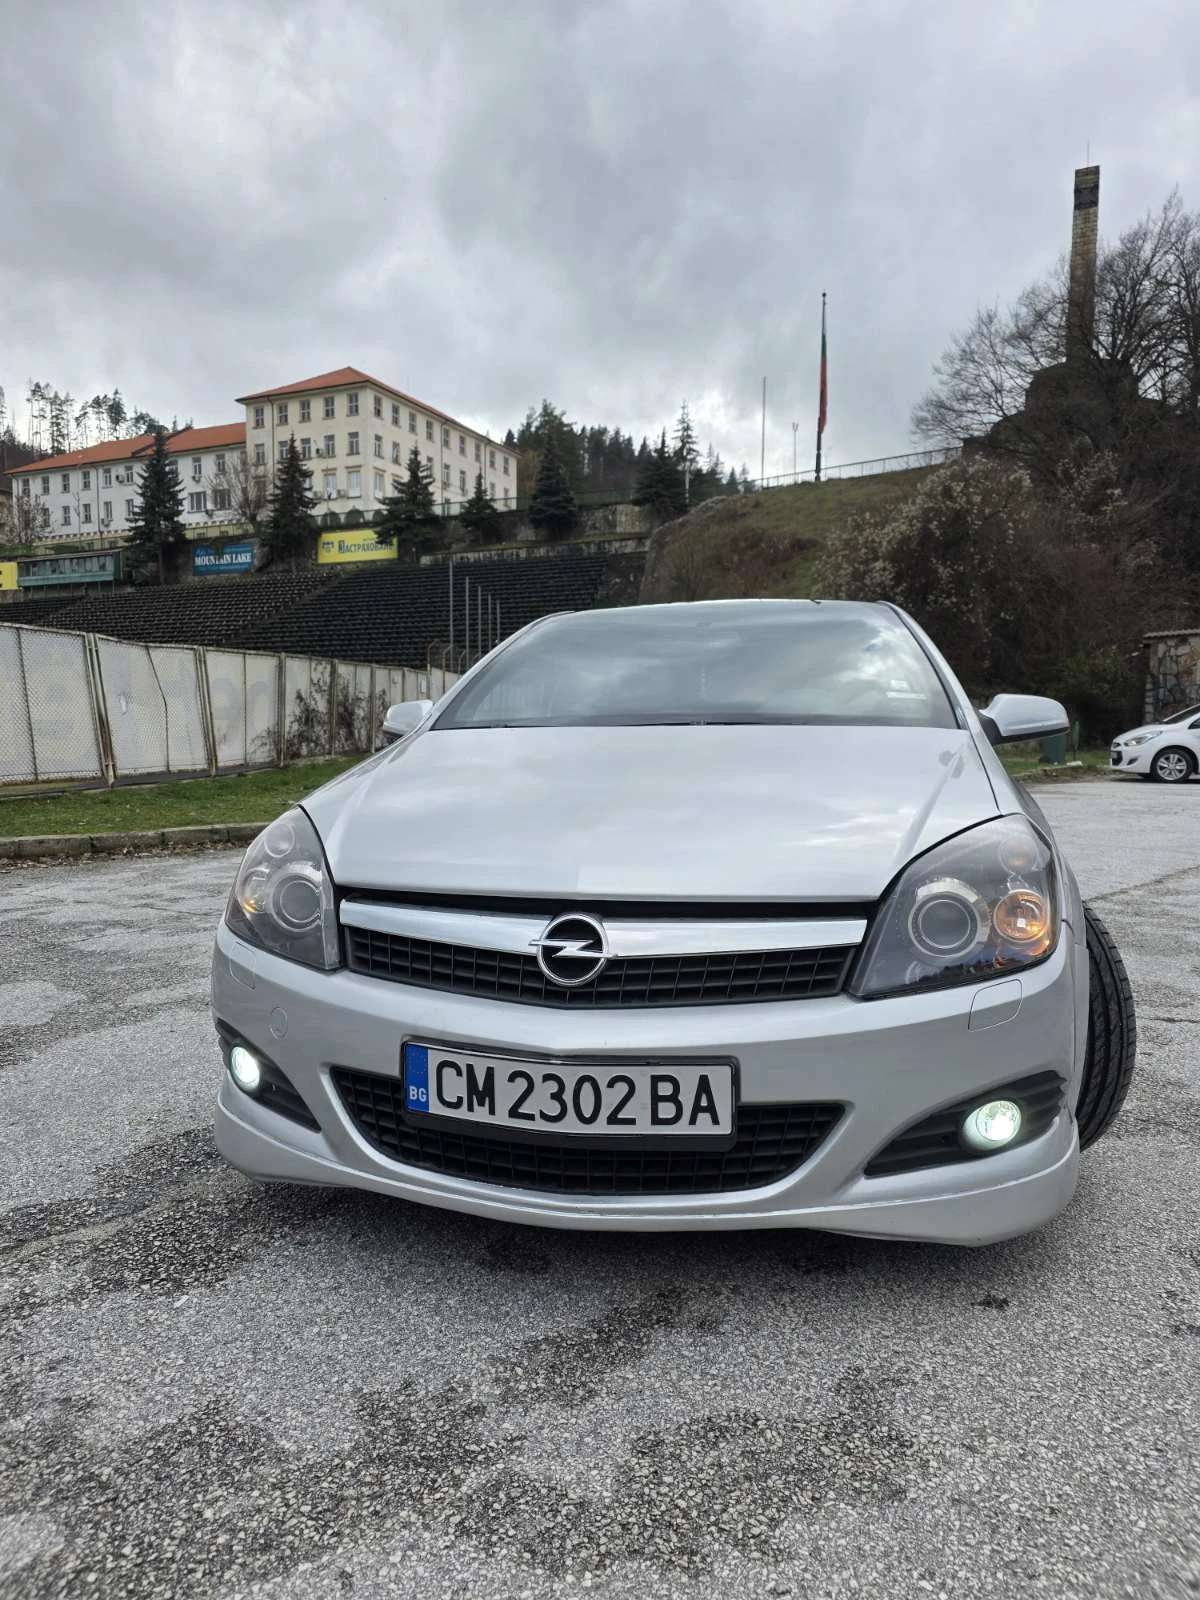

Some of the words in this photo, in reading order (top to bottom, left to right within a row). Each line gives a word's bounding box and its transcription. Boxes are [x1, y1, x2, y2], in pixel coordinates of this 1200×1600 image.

[232, 552, 252, 563] LAKE
[409, 1085, 427, 1102] BG
[436, 1060, 496, 1116] CM
[507, 1070, 637, 1126] 2302
[650, 1074, 720, 1126] BA
